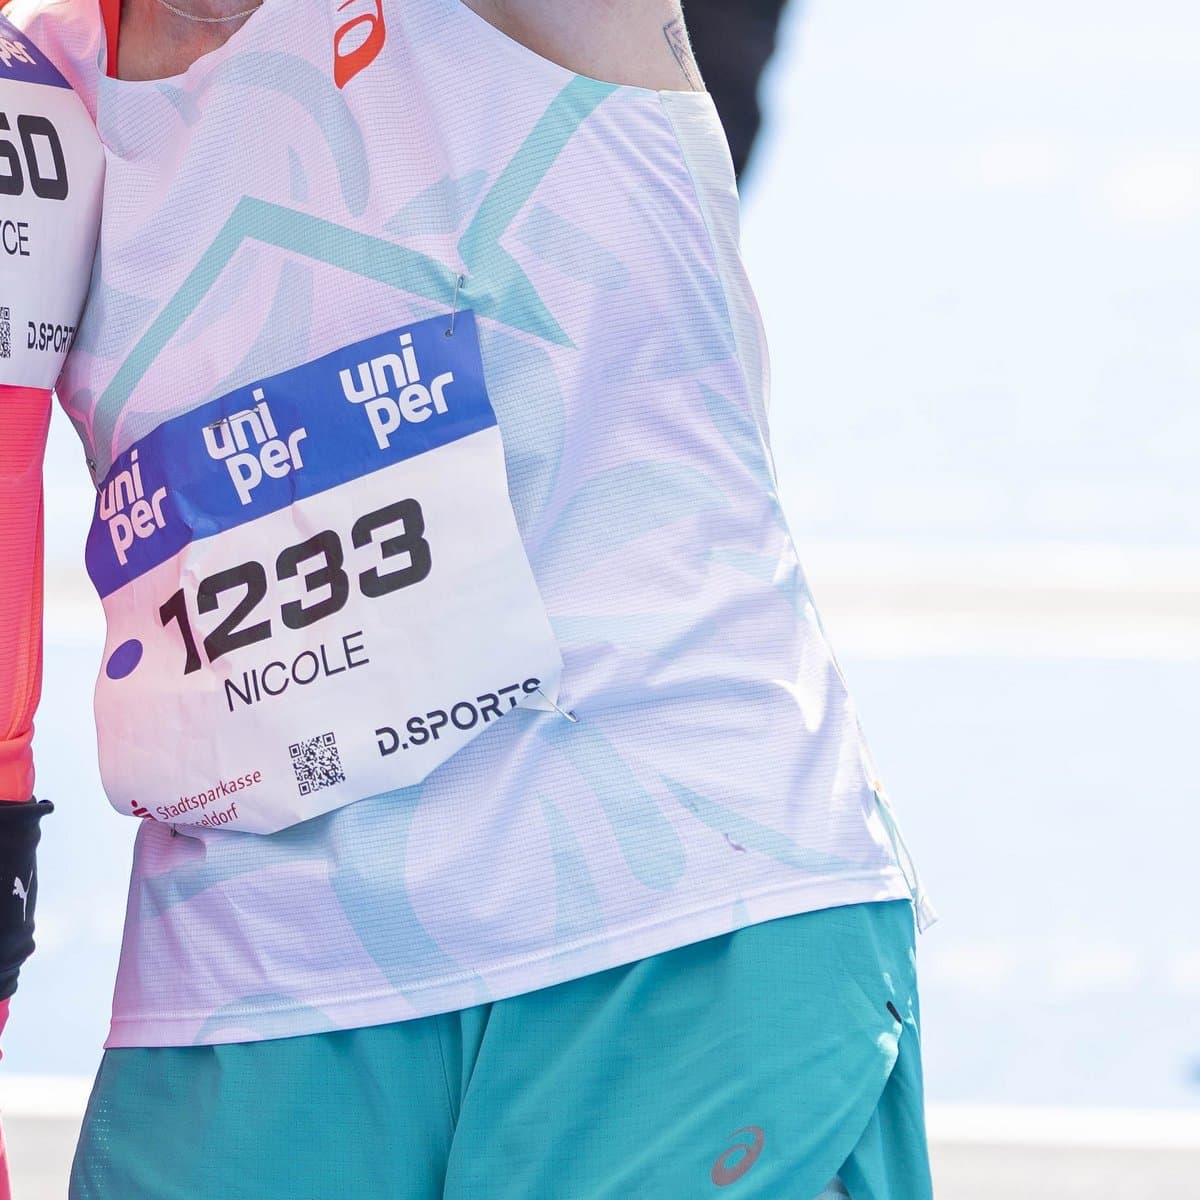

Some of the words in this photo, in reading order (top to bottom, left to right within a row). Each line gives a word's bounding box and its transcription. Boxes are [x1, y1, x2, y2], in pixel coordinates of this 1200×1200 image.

[27, 321, 77, 353] D.SPORT
[99, 448, 145, 521] uni
[202, 387, 278, 460] uni
[339, 332, 421, 404] uni
[108, 486, 167, 566] per
[225, 427, 307, 506] per
[364, 371, 454, 450] per
[159, 498, 432, 675] 1233
[224, 630, 370, 712] NICOLE
[157, 769, 262, 820] Stadtsparkasse
[194, 802, 238, 827] eldorf
